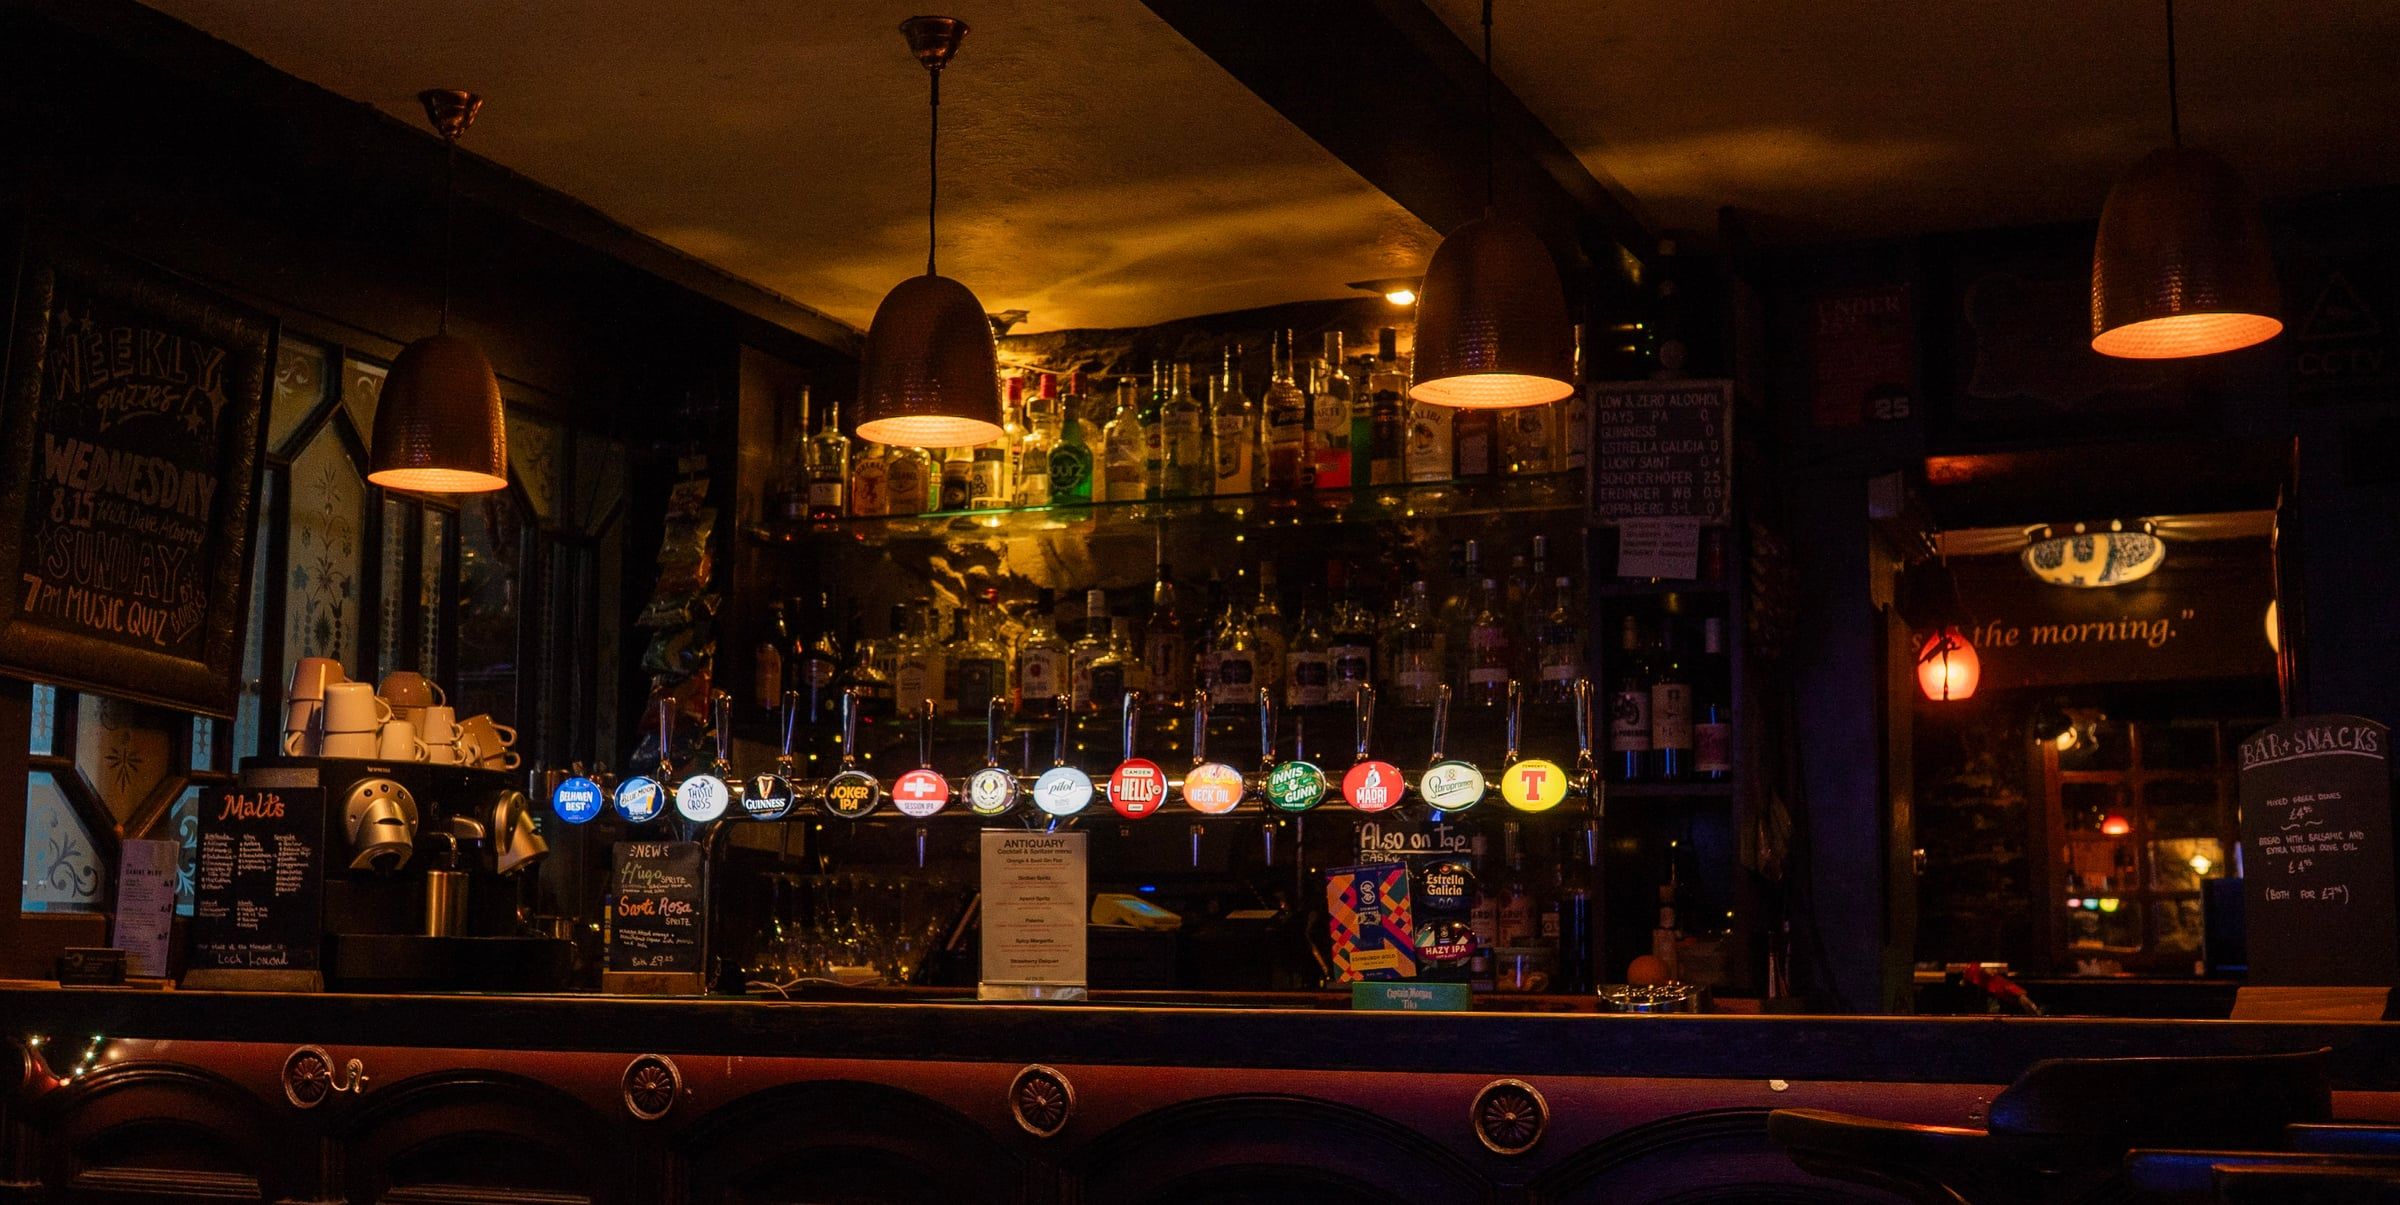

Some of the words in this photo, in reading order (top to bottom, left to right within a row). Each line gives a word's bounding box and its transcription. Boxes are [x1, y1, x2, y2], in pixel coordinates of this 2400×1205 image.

[50, 326, 226, 400] WEEKLY
[1600, 395, 1622, 408] LOW
[1637, 394, 1666, 407] ZERO
[1669, 393, 1720, 406] ALCOHOL
[1601, 410, 1635, 424] DAYS
[1602, 441, 1657, 455] ESTRELLA
[1660, 440, 1704, 453] GALICIA
[45, 432, 218, 525] WEDNESDAY
[1600, 488, 1660, 500] ERDINGER
[48, 525, 188, 604] SUNDAY
[66, 585, 125, 633] MUSIC
[127, 601, 168, 646] QUIZ
[1973, 620, 2019, 648] the
[2031, 609, 2195, 648] morning."
[2241, 731, 2285, 764] BAR
[2294, 726, 2378, 753] SNACKS
[1272, 766, 1304, 785] INNIS
[1048, 780, 1075, 795] pilot
[1120, 778, 1154, 802] HELLS
[1287, 778, 1299, 791] &
[1521, 770, 1547, 801] T
[559, 790, 593, 803] BELHAVEN
[830, 786, 869, 799] JOKER
[1191, 788, 1215, 801] NECK
[1284, 786, 1317, 803] GUNN
[565, 802, 586, 811] BEST
[687, 799, 711, 811] CROSS
[745, 798, 786, 810] GUINNESS
[840, 798, 858, 810] IPA
[904, 802, 925, 810] SESSION
[926, 802, 934, 810] IPA
[1361, 821, 1405, 850] Also
[1410, 832, 1432, 849] on
[1434, 822, 1467, 852] Tap
[2348, 830, 2364, 840] AND
[1003, 839, 1065, 848] ANTIQUARY
[635, 845, 661, 858] NEW
[1426, 873, 1464, 885] Estrella
[1426, 885, 1462, 896] Galicia
[1425, 946, 1450, 955] HAZY
[1451, 945, 1467, 953] IPA
